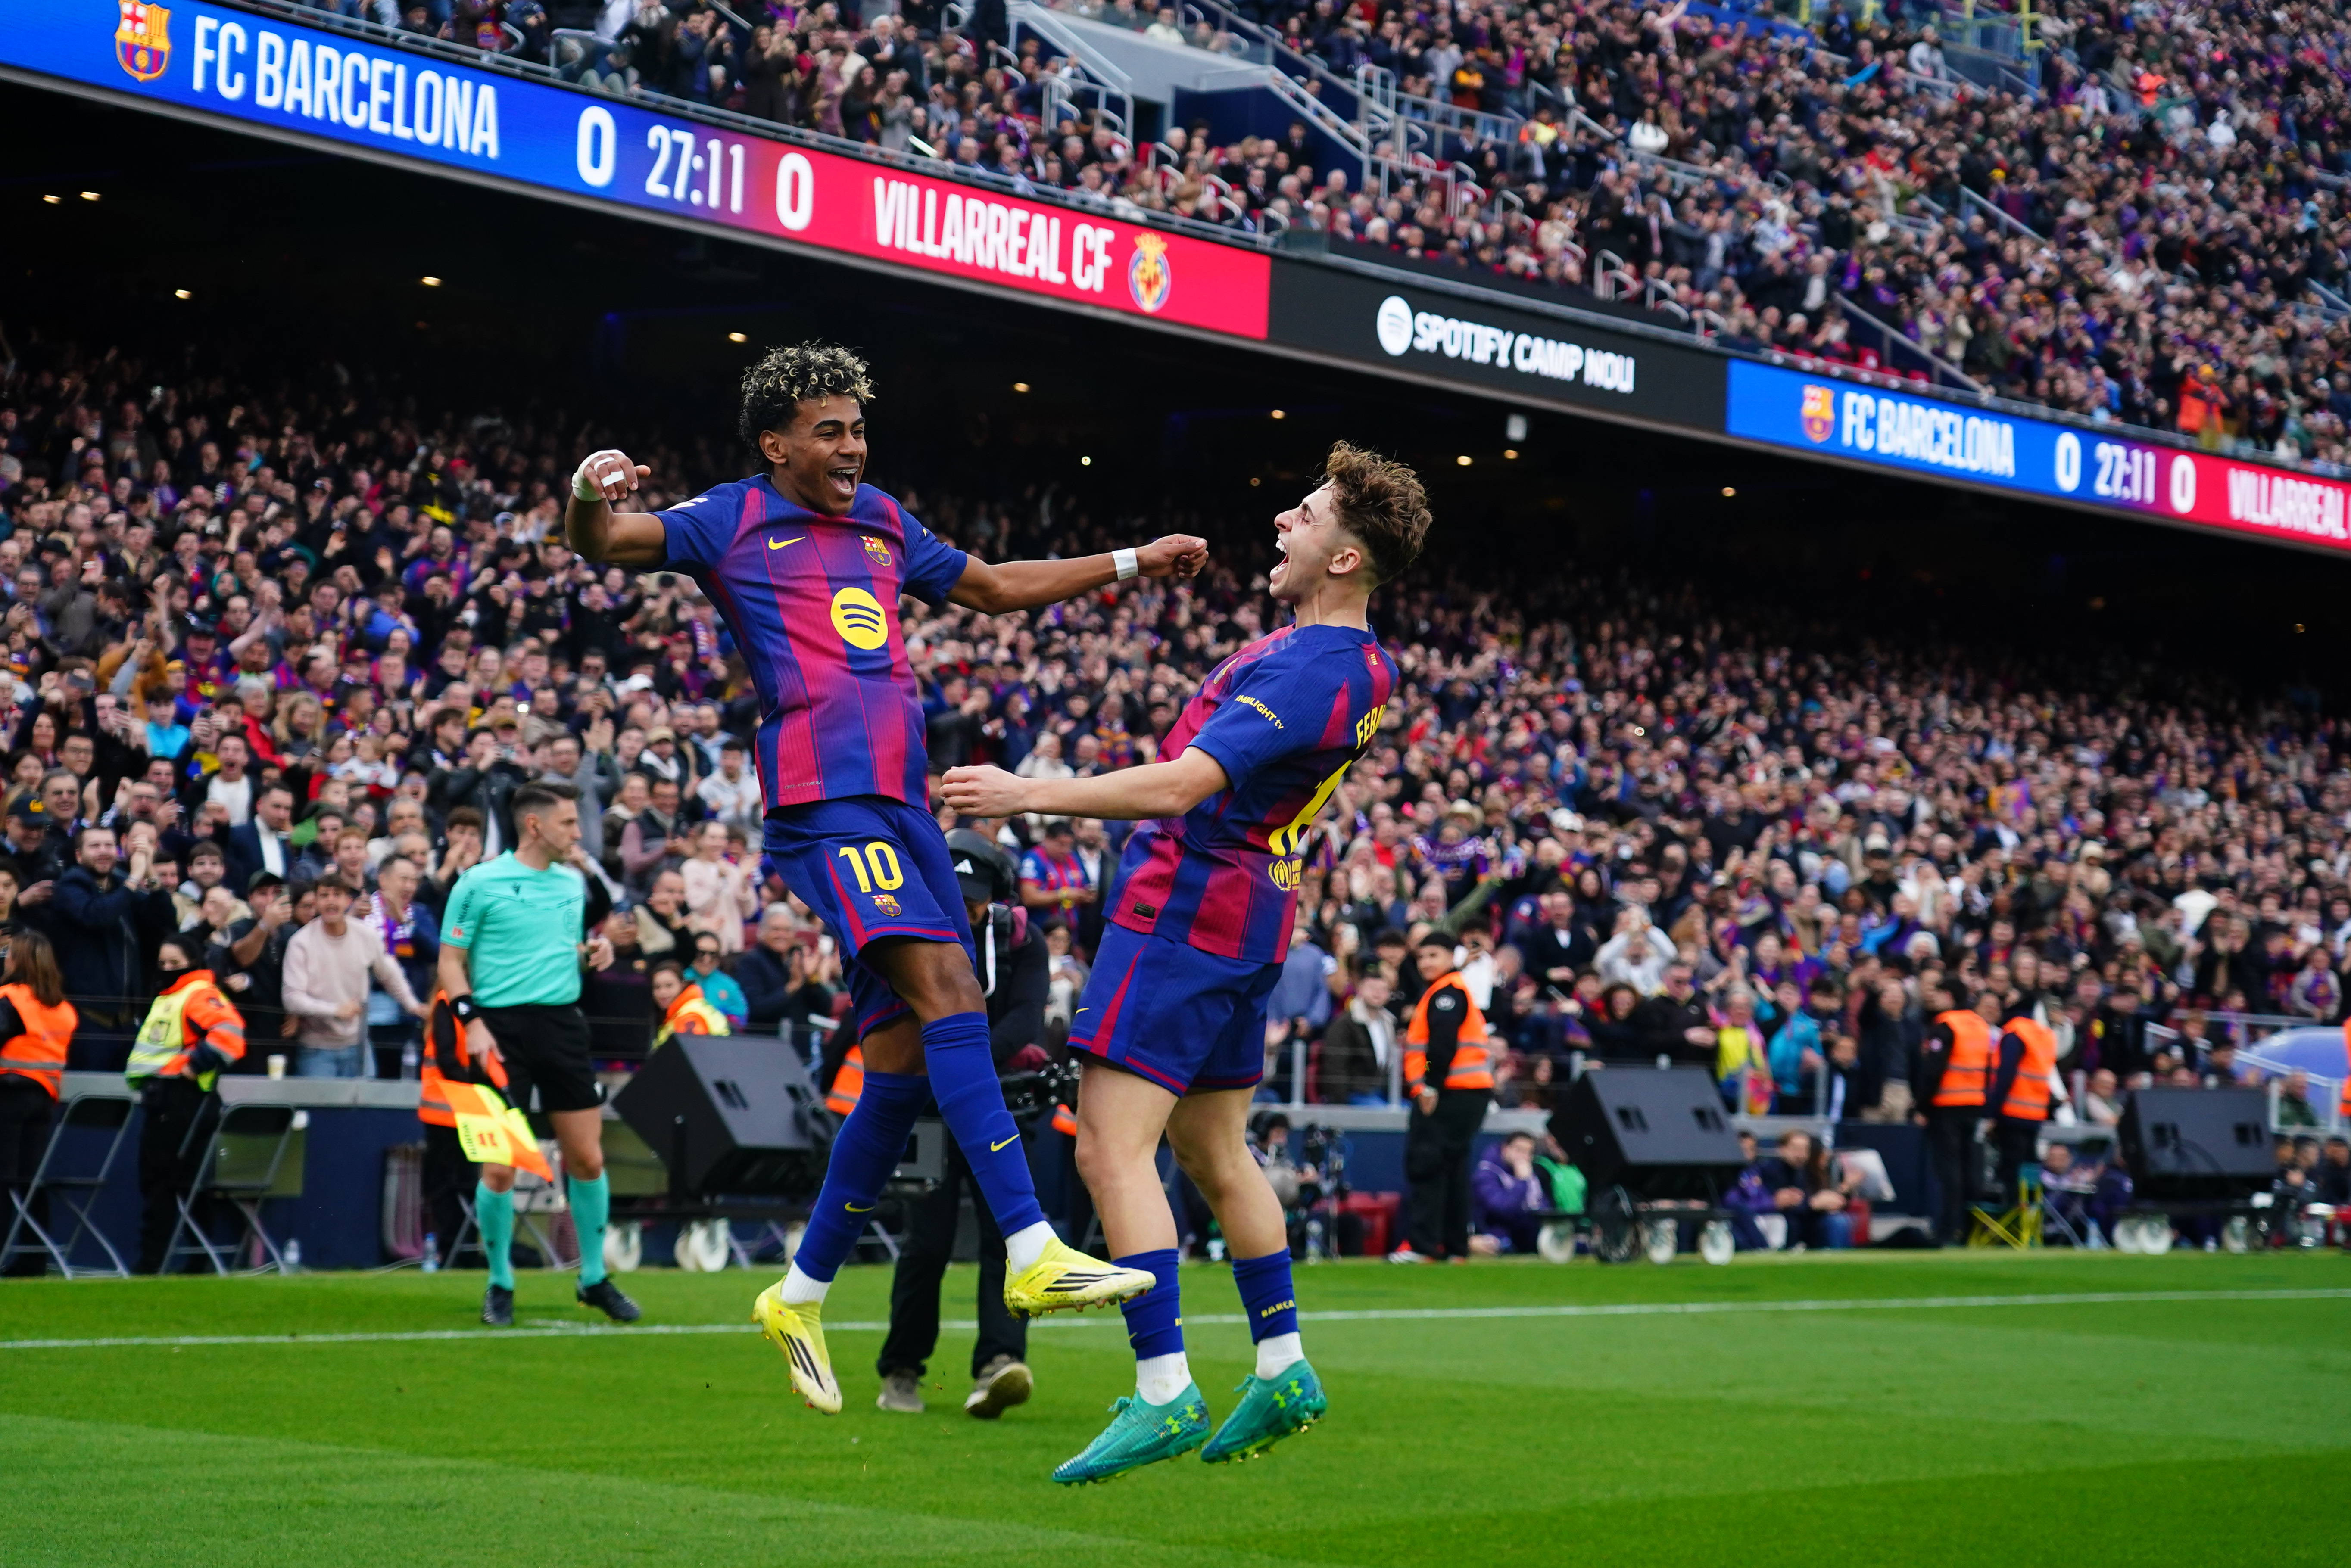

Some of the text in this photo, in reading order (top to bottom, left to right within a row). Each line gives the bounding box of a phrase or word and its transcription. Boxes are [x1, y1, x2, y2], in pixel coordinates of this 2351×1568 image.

[193, 15, 500, 159] FC BARCELONA
[577, 106, 616, 187] 0
[645, 124, 745, 215] 27:11
[776, 152, 814, 231] 0
[874, 177, 1115, 292] VILLARREAL CF
[1413, 312, 1635, 393] SPOTIFY CAMP NOU
[1842, 391, 2015, 478] FC BARCELONA
[2055, 432, 2081, 492] 0
[2094, 442, 2156, 504] 27:11
[2170, 454, 2196, 514] 0
[2228, 468, 2348, 539] VILLARREAL
[839, 841, 904, 893] 10
